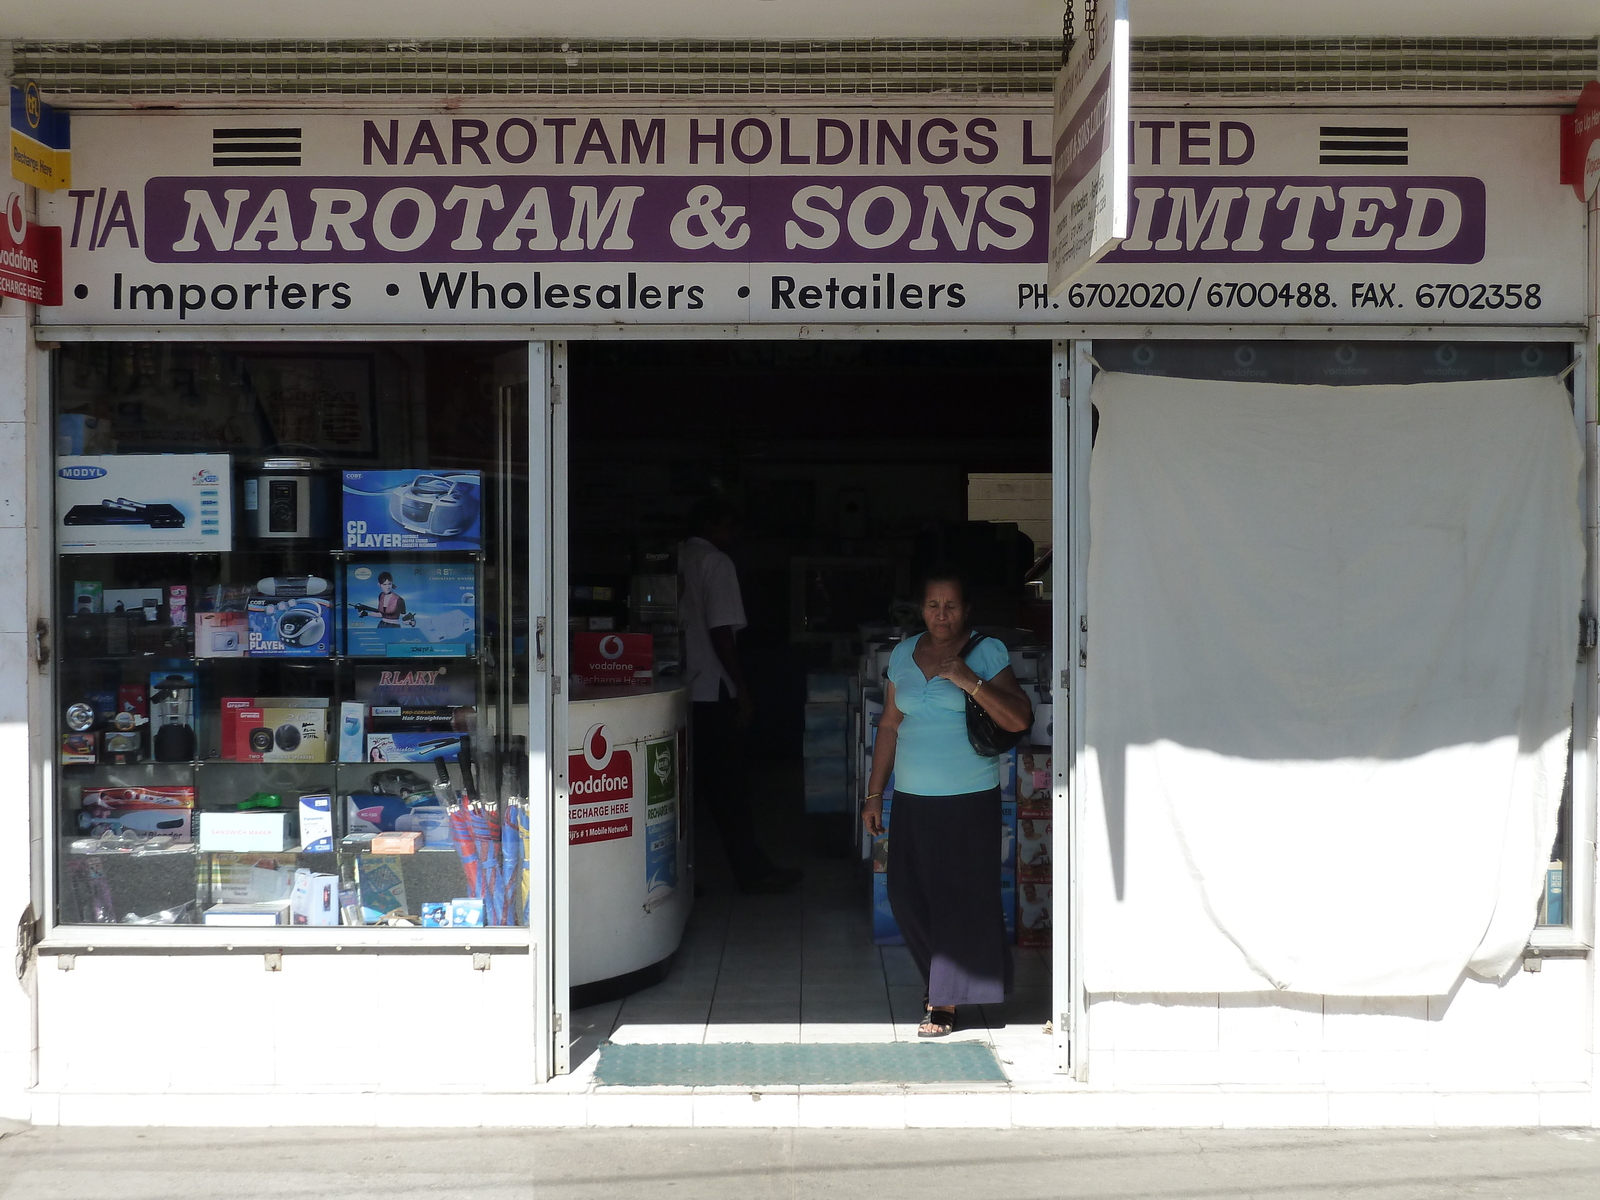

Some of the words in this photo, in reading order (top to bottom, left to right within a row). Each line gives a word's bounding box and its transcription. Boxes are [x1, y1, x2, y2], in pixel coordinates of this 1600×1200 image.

[1574, 118, 1583, 136] Top
[1583, 113, 1592, 133] Up
[363, 117, 666, 166] NAROTAM
[689, 117, 999, 165] HOLDINGS
[1022, 119, 1256, 166] LITED
[13, 146, 39, 173] Recharge
[39, 158, 53, 177] Here
[68, 189, 139, 252] T/A
[172, 184, 645, 253] NAROTAM
[669, 184, 751, 252] &
[785, 184, 1036, 252] SONS
[1112, 185, 1464, 253] IMITED
[27, 284, 43, 301] HERE
[113, 272, 352, 319] Importers
[419, 271, 705, 310] Wholesalers
[771, 273, 966, 310] Retailers
[1018, 283, 1059, 309] PH.
[1351, 282, 1404, 309] FAX.
[1416, 282, 1542, 310] 6702358
[1323, 366, 1369, 375] vodafone
[1423, 366, 1468, 375] vodafone
[62, 467, 103, 477] MODYL
[347, 520, 367, 534] CD
[347, 534, 402, 548] PLAYER
[645, 552, 670, 561] Energizer
[249, 632, 262, 641] CD
[249, 641, 285, 650] PLAYER
[589, 661, 634, 671] vodafone
[379, 670, 439, 686] RLAKY
[623, 676, 646, 686] Here
[415, 715, 452, 723] Straightener
[568, 773, 629, 796] vodafone
[568, 804, 609, 820] RECHARGE
[610, 802, 629, 816] HERE
[569, 830, 580, 841] iji's
[589, 826, 608, 837] Mobile
[608, 824, 629, 835] Network
